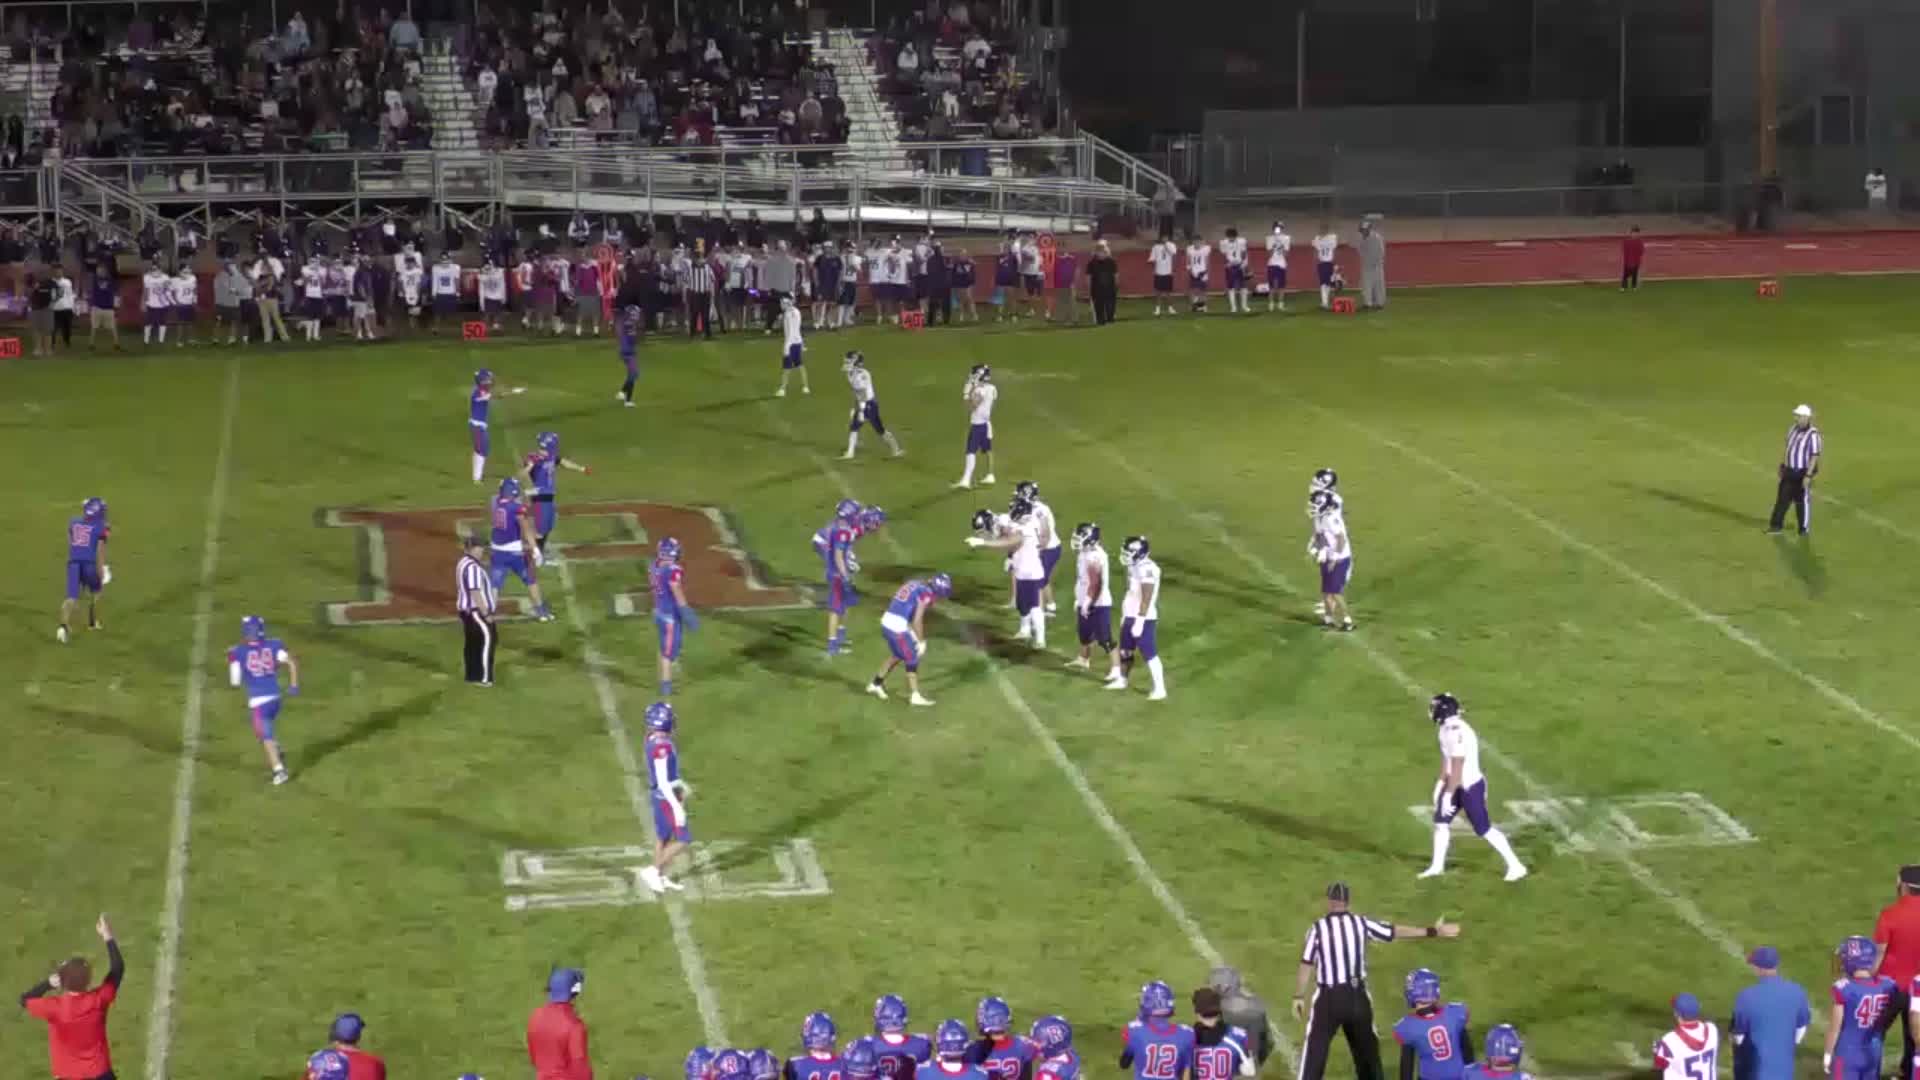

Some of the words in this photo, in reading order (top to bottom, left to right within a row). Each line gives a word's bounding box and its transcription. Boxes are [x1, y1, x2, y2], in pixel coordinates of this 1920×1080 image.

[464, 323, 484, 338] 50
[502, 838, 834, 911] 50
[1427, 1024, 1453, 1062] 9
[1141, 1043, 1178, 1079] 12
[1194, 1047, 1233, 1080] 50
[1683, 1048, 1716, 1080] 57
